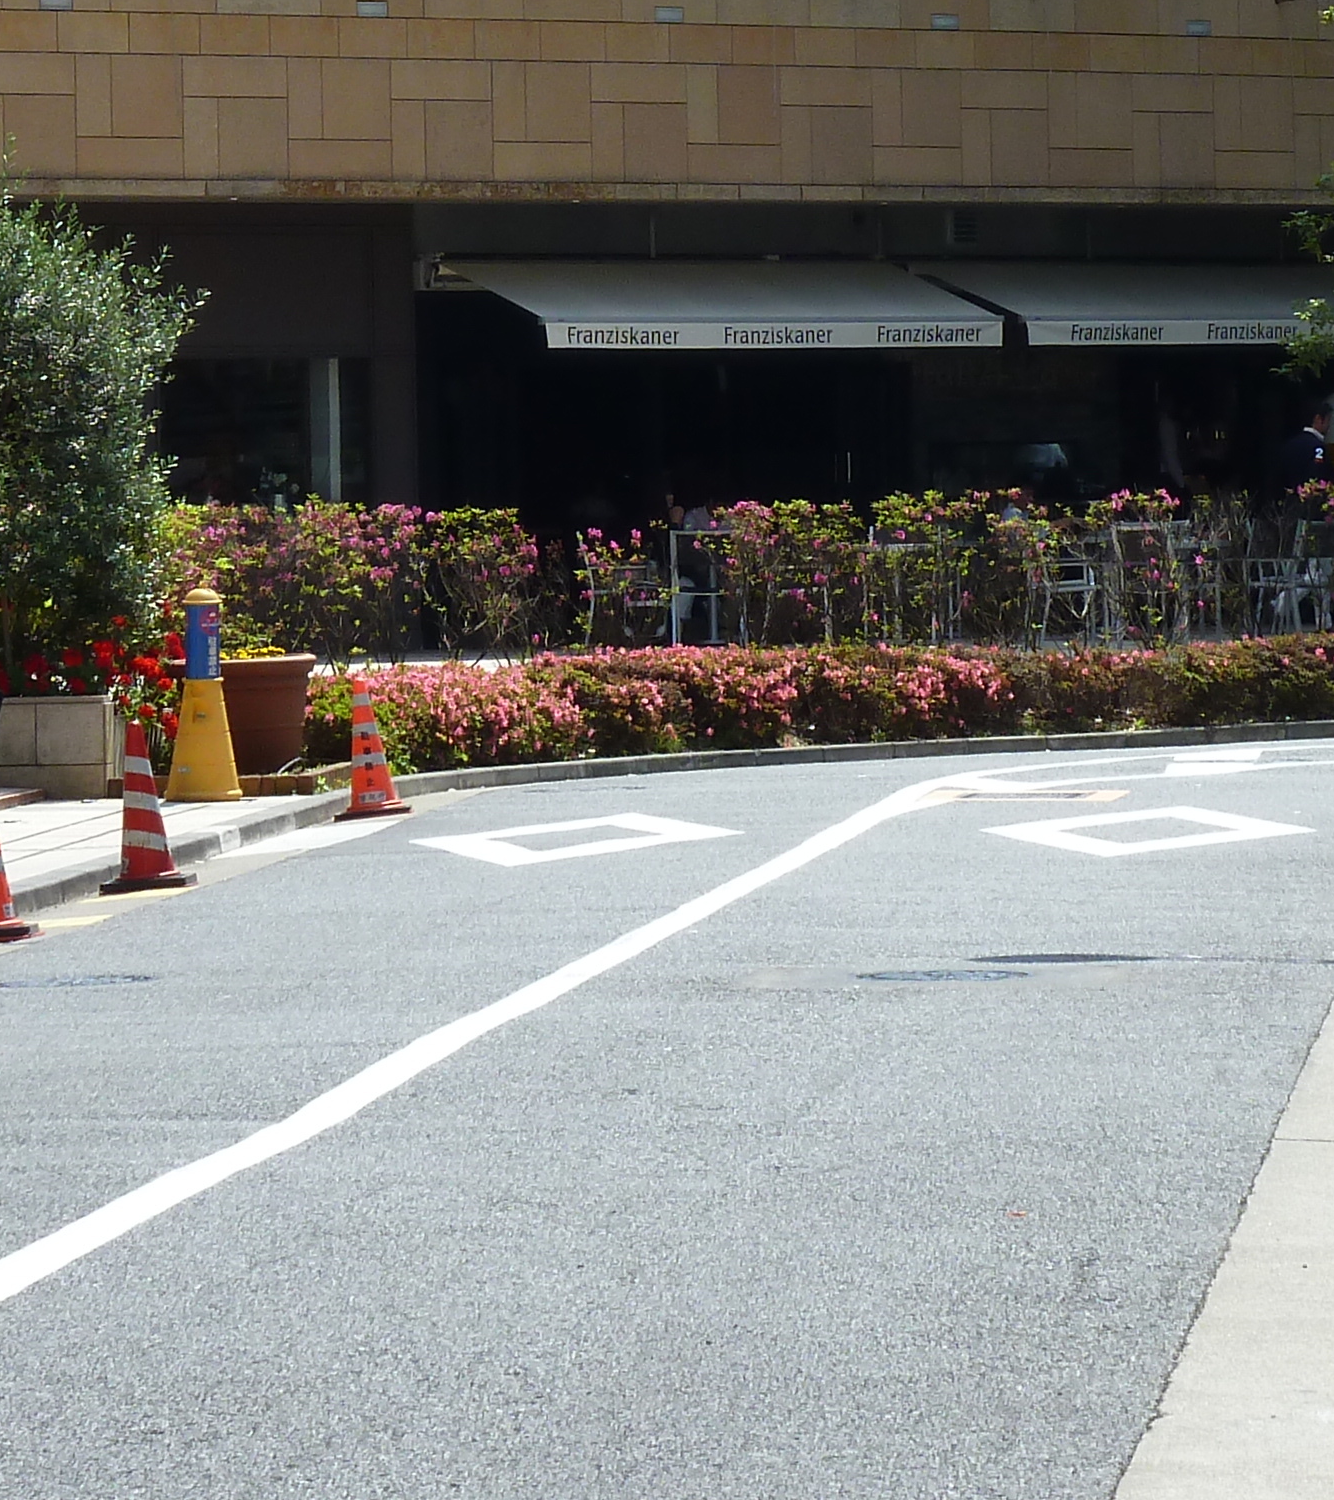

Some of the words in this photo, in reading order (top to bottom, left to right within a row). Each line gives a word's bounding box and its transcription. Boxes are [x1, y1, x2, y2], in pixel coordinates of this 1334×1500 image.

[567, 325, 680, 345] Franziskaner
[723, 325, 833, 345] Franziskaner
[876, 324, 983, 343] Franziskaner
[1070, 322, 1164, 342] Franziskaner
[1207, 322, 1298, 341] Franziskaner
[1314, 447, 1324, 459] 2
